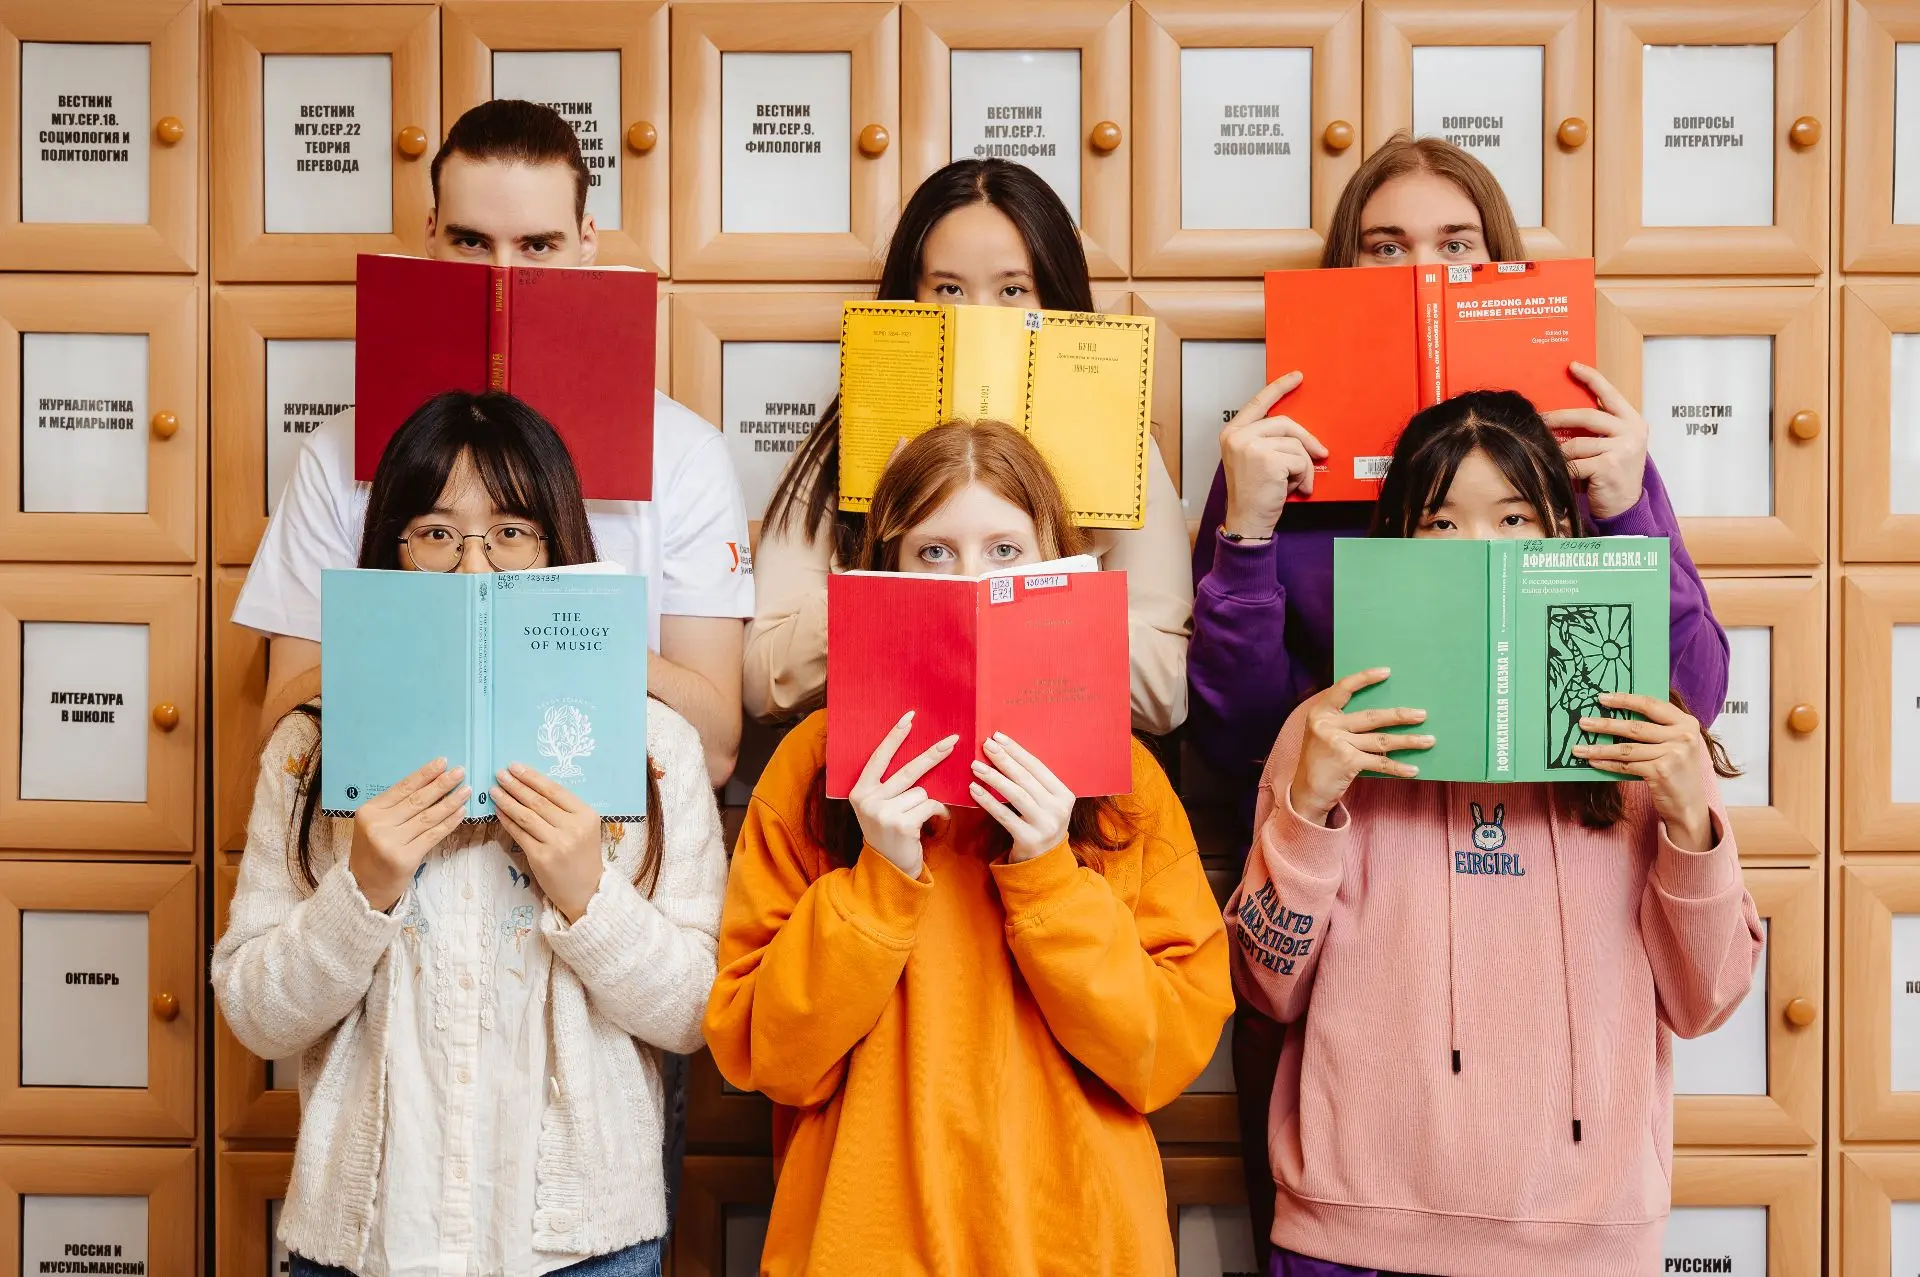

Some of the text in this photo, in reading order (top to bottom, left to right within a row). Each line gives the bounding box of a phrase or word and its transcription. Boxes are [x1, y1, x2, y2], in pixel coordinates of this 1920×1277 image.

[58, 95, 112, 107] ВЕСТНИК
[300, 105, 355, 117] ВЕСТНИК
[756, 104, 811, 117] ВЕСТНИК
[987, 106, 1042, 119] ВЕСТНИК
[1224, 105, 1280, 118] ВЕСТНИК
[51, 113, 119, 126] МГУ.СЕР.18.
[1442, 116, 1503, 129] ВОПРОСЫ
[1673, 116, 1734, 129] ВОПРОСЫ
[294, 123, 361, 136] МГУ.СЕР.22
[752, 122, 815, 135] МГУ.СЕР.9.
[984, 125, 1045, 138] МГУ.СЕР.7.
[1220, 123, 1284, 137] МГУ.СЕР.6.
[39, 131, 130, 145] СОЦИОЛОГИЯ И
[1664, 134, 1743, 147] ЛИТЕРАТУРЫ
[305, 141, 350, 153] ТЕОРИЯ
[745, 141, 821, 153] ФИЛОЛОГИЯ
[973, 143, 1056, 157] ФИЛОСОФИЯ
[1213, 142, 1291, 155] ЭКОНОМИКА
[41, 149, 128, 161] ПОЛИТОЛОГИЯ
[296, 159, 359, 173] ПЕРЕВОДА
[1456, 296, 1568, 309] MAO ZEDONG AND THE
[1458, 305, 1568, 318] CHINESE REVOLUTION
[39, 398, 134, 412] ЖУРНАЛИСТИКА
[765, 403, 816, 416] ЖУРНАЛ
[1671, 405, 1733, 418] ИЗВЕСТИЯ
[38, 416, 134, 430] И МЕДИАРЫНОК
[283, 421, 291, 433] И
[1685, 423, 1718, 435] УРФУ
[1523, 552, 1599, 567] АФРИКАНСКАЯ
[1602, 552, 1641, 567] СКАЗКА
[552, 612, 582, 622] THE
[523, 626, 611, 637] SOCIOLOGY
[531, 640, 603, 651] OF MUSIC
[1497, 657, 1509, 694] СКАЗКА
[50, 691, 124, 706] ЛИТЕРАТУРА
[61, 710, 115, 723] В ШКОЛЕ
[1497, 698, 1509, 771] АФРИКАНСКАЯ
[1455, 851, 1525, 876] EIRGIRL
[65, 972, 120, 986] ОКТЯБРЬ
[64, 1244, 122, 1257] РОССИЯ И
[40, 1260, 145, 1276] МУСУЛЬМАНСКИЙ
[1665, 1255, 1732, 1273] РУССКИЙ
